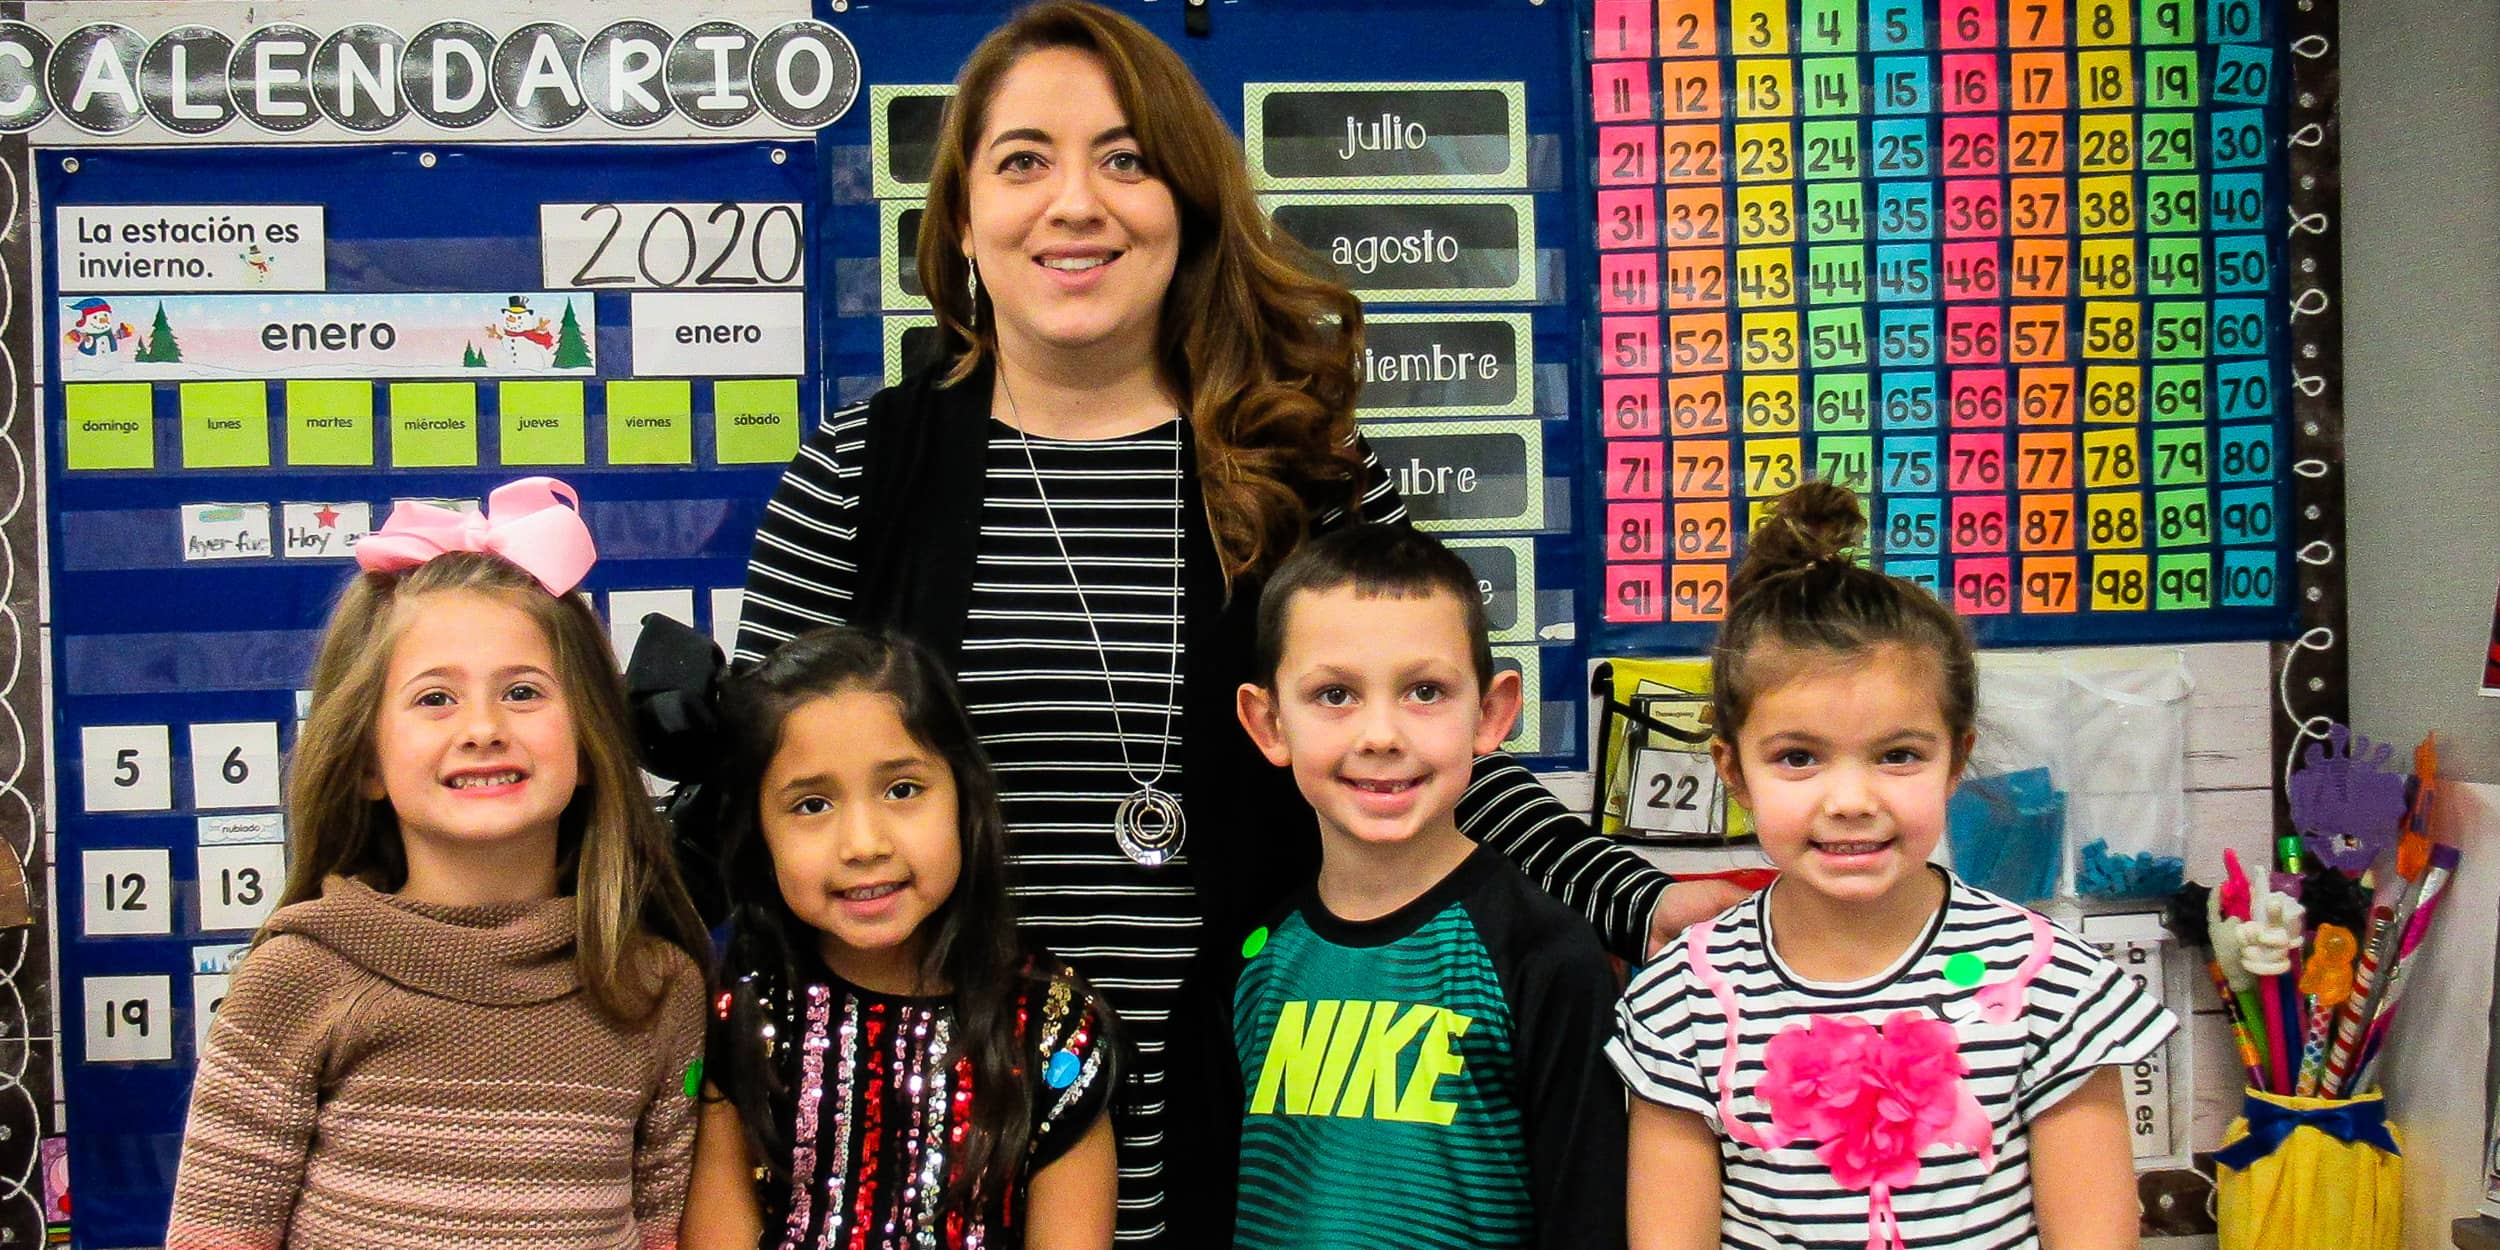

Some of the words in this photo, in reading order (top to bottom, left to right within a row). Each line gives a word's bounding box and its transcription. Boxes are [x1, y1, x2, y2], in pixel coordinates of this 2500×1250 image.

[1619, 15, 1626, 50] 1
[1677, 13, 1699, 49] 2
[1750, 12, 1771, 47] 3
[1818, 10, 1841, 45] 4
[1886, 8, 1908, 43] 5
[1957, 7, 1980, 41] 6
[2026, 5, 2047, 41] 7
[2093, 4, 2114, 39] 8
[2157, 2, 2180, 37] 9
[2218, 0, 2251, 36] 10
[0, 36, 834, 119] CALENDARIO
[1613, 78, 1631, 113] 11
[1675, 77, 1708, 112] 12
[1748, 75, 1781, 110] 13
[1815, 73, 1848, 108] 14
[1886, 72, 1917, 107] 15
[1955, 70, 1987, 105] 16
[2024, 68, 2053, 103] 17
[2091, 66, 2122, 101] 18
[2157, 66, 2188, 100] 19
[2217, 60, 2268, 97] 20
[1338, 113, 1428, 161] julio
[1612, 142, 1644, 178] 21
[1669, 141, 1718, 177] 22
[1741, 138, 1788, 175] 23
[1808, 136, 1855, 172] 24
[1879, 134, 1924, 170] 25
[1948, 133, 1995, 169] 26
[2015, 131, 2059, 166] 27
[2083, 130, 2129, 166] 28
[2147, 128, 2192, 163] 29
[2214, 124, 2263, 161] 30
[77, 217, 113, 245] La
[121, 213, 256, 246] estación
[265, 225, 300, 246] es
[1612, 205, 1643, 241] 31
[1672, 203, 1720, 240] 32
[1743, 200, 1790, 238] 33
[1812, 199, 1860, 234] 34
[1883, 198, 1928, 233] 35
[1950, 195, 1998, 231] 36
[2016, 193, 2060, 229] 37
[2084, 191, 2130, 228] 38
[2151, 190, 2196, 225] 39
[2213, 188, 2262, 222] 40
[571, 203, 801, 288] 2020
[1331, 229, 1459, 276] agosto
[78, 252, 213, 280] invierno.
[1612, 269, 1646, 305] 41
[1671, 265, 1722, 301] 42
[1740, 263, 1790, 299] 43
[1812, 261, 1862, 296] 44
[1880, 259, 1928, 294] 45
[1947, 257, 1996, 292] 46
[2017, 255, 2064, 291] 47
[2083, 254, 2132, 290] 48
[2151, 253, 2199, 287] 49
[2219, 250, 2267, 286] 50
[262, 319, 397, 352] enero
[675, 322, 762, 344] enero
[1615, 332, 1647, 367] 51
[1675, 329, 1723, 366] 52
[1747, 327, 1794, 364] 53
[1813, 323, 1861, 360] 54
[1884, 324, 1930, 359] 55
[1951, 322, 1997, 357] 56
[2015, 320, 2060, 356] 57
[2088, 317, 2134, 352] 58
[2157, 317, 2202, 352] 59
[2217, 314, 2264, 348] 60
[1365, 344, 1499, 382] iembre
[733, 412, 780, 427] sábado
[1616, 394, 1648, 429] 61
[1674, 391, 1723, 429] 62
[1747, 390, 1795, 426] 63
[1817, 389, 1865, 424] 64
[1887, 387, 1933, 422] 65
[1955, 386, 2003, 420] 66
[2024, 383, 2069, 418] 67
[2089, 382, 2135, 416] 68
[2155, 379, 2202, 414] 69
[2221, 376, 2269, 413] 70
[82, 417, 140, 434] domingo
[207, 417, 242, 432] lunes
[306, 418, 353, 429] martes
[404, 416, 465, 431] miércoles
[517, 416, 560, 432] jueves
[624, 415, 671, 429] viernes
[1619, 457, 1651, 493] 71
[1678, 456, 1724, 492] 72
[1749, 453, 1797, 491] 73
[1821, 452, 1868, 486] 74
[1887, 451, 1931, 487] 75
[1955, 449, 1999, 484] 76
[2024, 448, 2067, 483] 77
[2088, 444, 2135, 481] 78
[2158, 442, 2203, 479] 79
[2223, 440, 2272, 475] 80
[288, 526, 331, 554] Hoy
[1619, 518, 1651, 553] 81
[1679, 517, 1727, 553] 82
[1890, 513, 1936, 548] 85
[1956, 512, 2003, 547] 86
[2025, 509, 2069, 544] 87
[2092, 508, 2138, 543] 88
[2161, 503, 2206, 540] 89
[2223, 502, 2272, 537] 90
[1617, 580, 1651, 615] 91
[1675, 579, 1724, 615] 92
[1958, 573, 2006, 607] 96
[2027, 572, 2072, 606] 97
[2096, 570, 2144, 604] 98
[2161, 568, 2207, 602] 99
[2224, 566, 2273, 598] 100
[114, 749, 140, 786] 5
[222, 747, 249, 785] 6
[1647, 773, 1700, 811] 22
[104, 874, 147, 911] 12
[221, 867, 264, 907] 13
[105, 999, 149, 1038] 19
[1249, 1000, 1472, 1125] NIKE
